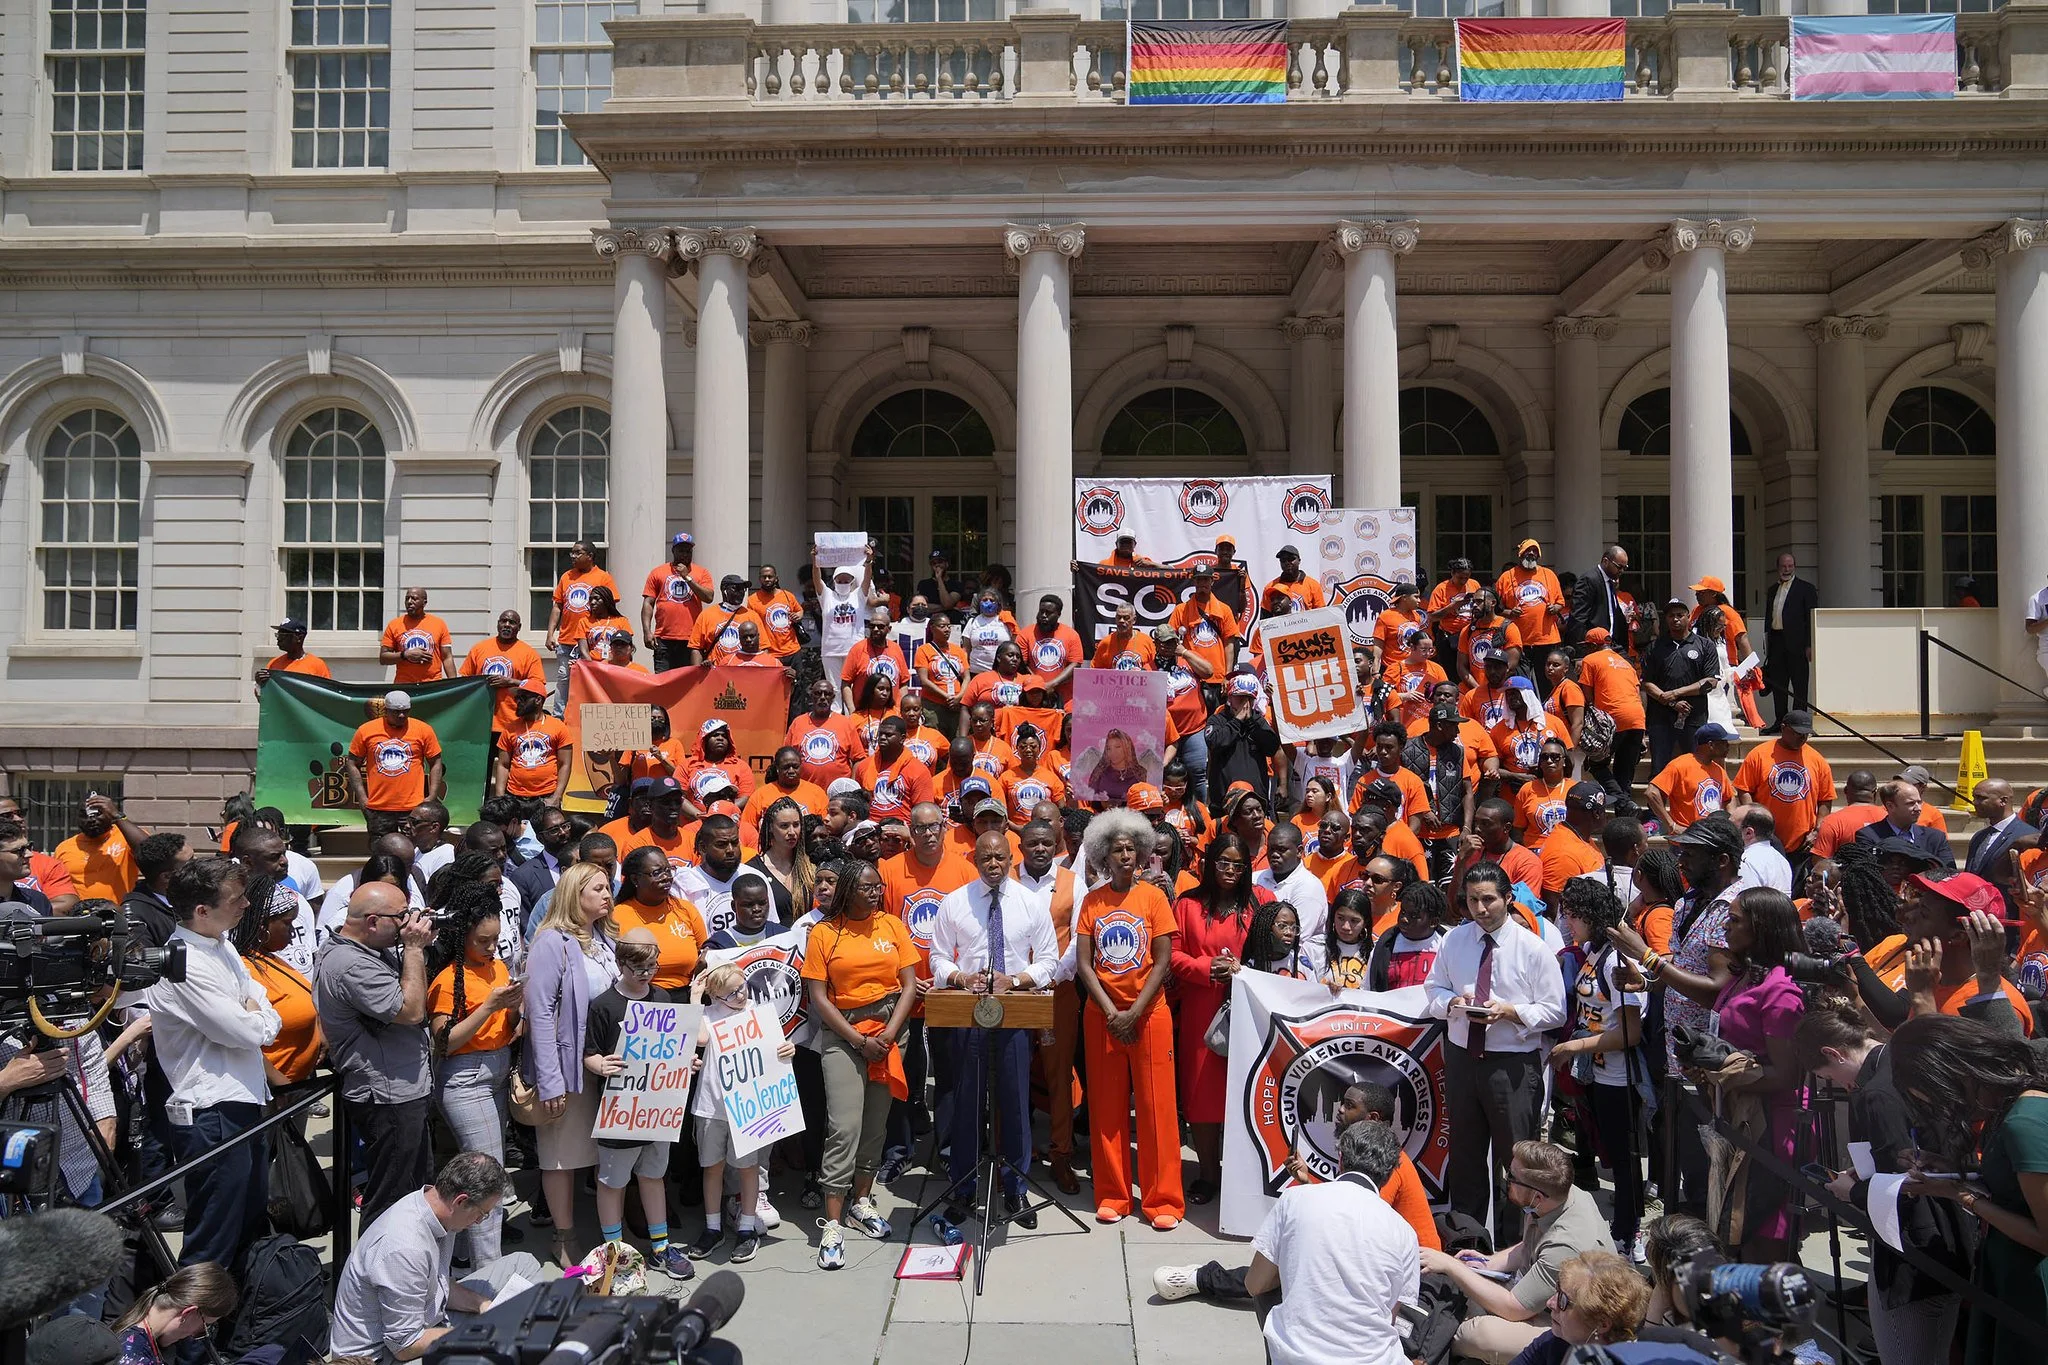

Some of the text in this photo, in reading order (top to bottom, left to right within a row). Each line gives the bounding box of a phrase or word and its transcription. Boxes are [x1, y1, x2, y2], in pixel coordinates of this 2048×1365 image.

[1097, 567, 1221, 581] SAVE OUR STRS
[1192, 557, 1216, 567] UNITY
[1358, 579, 1378, 587] UNITY
[1243, 589, 1252, 623] EALING
[1342, 589, 1372, 608] VIOLENCE
[1278, 631, 1335, 655] GUNS
[1349, 633, 1374, 645] MOVEM
[1278, 643, 1337, 664] DOWN
[1092, 675, 1148, 687] JUSTICE
[1282, 656, 1343, 693] LIFE
[584, 704, 650, 720] HELP KEEP
[1287, 684, 1346, 717] UP
[593, 730, 645, 747] SAFE!!!
[600, 720, 638, 731] US ALL
[750, 950, 773, 959] UNITY
[769, 961, 802, 996] AWARENESS
[624, 1003, 677, 1035] Save
[712, 1009, 764, 1054] End
[1329, 1021, 1384, 1033] UNITY
[622, 1033, 688, 1062] Kids!
[605, 1062, 690, 1093] End Gun
[1283, 1040, 1430, 1133] GUN VIOLENCE AWARENESS
[724, 1072, 798, 1129] Violence
[1263, 1075, 1277, 1127] HOPE
[1434, 1068, 1451, 1149] HEALING
[598, 1096, 685, 1132] Violence
